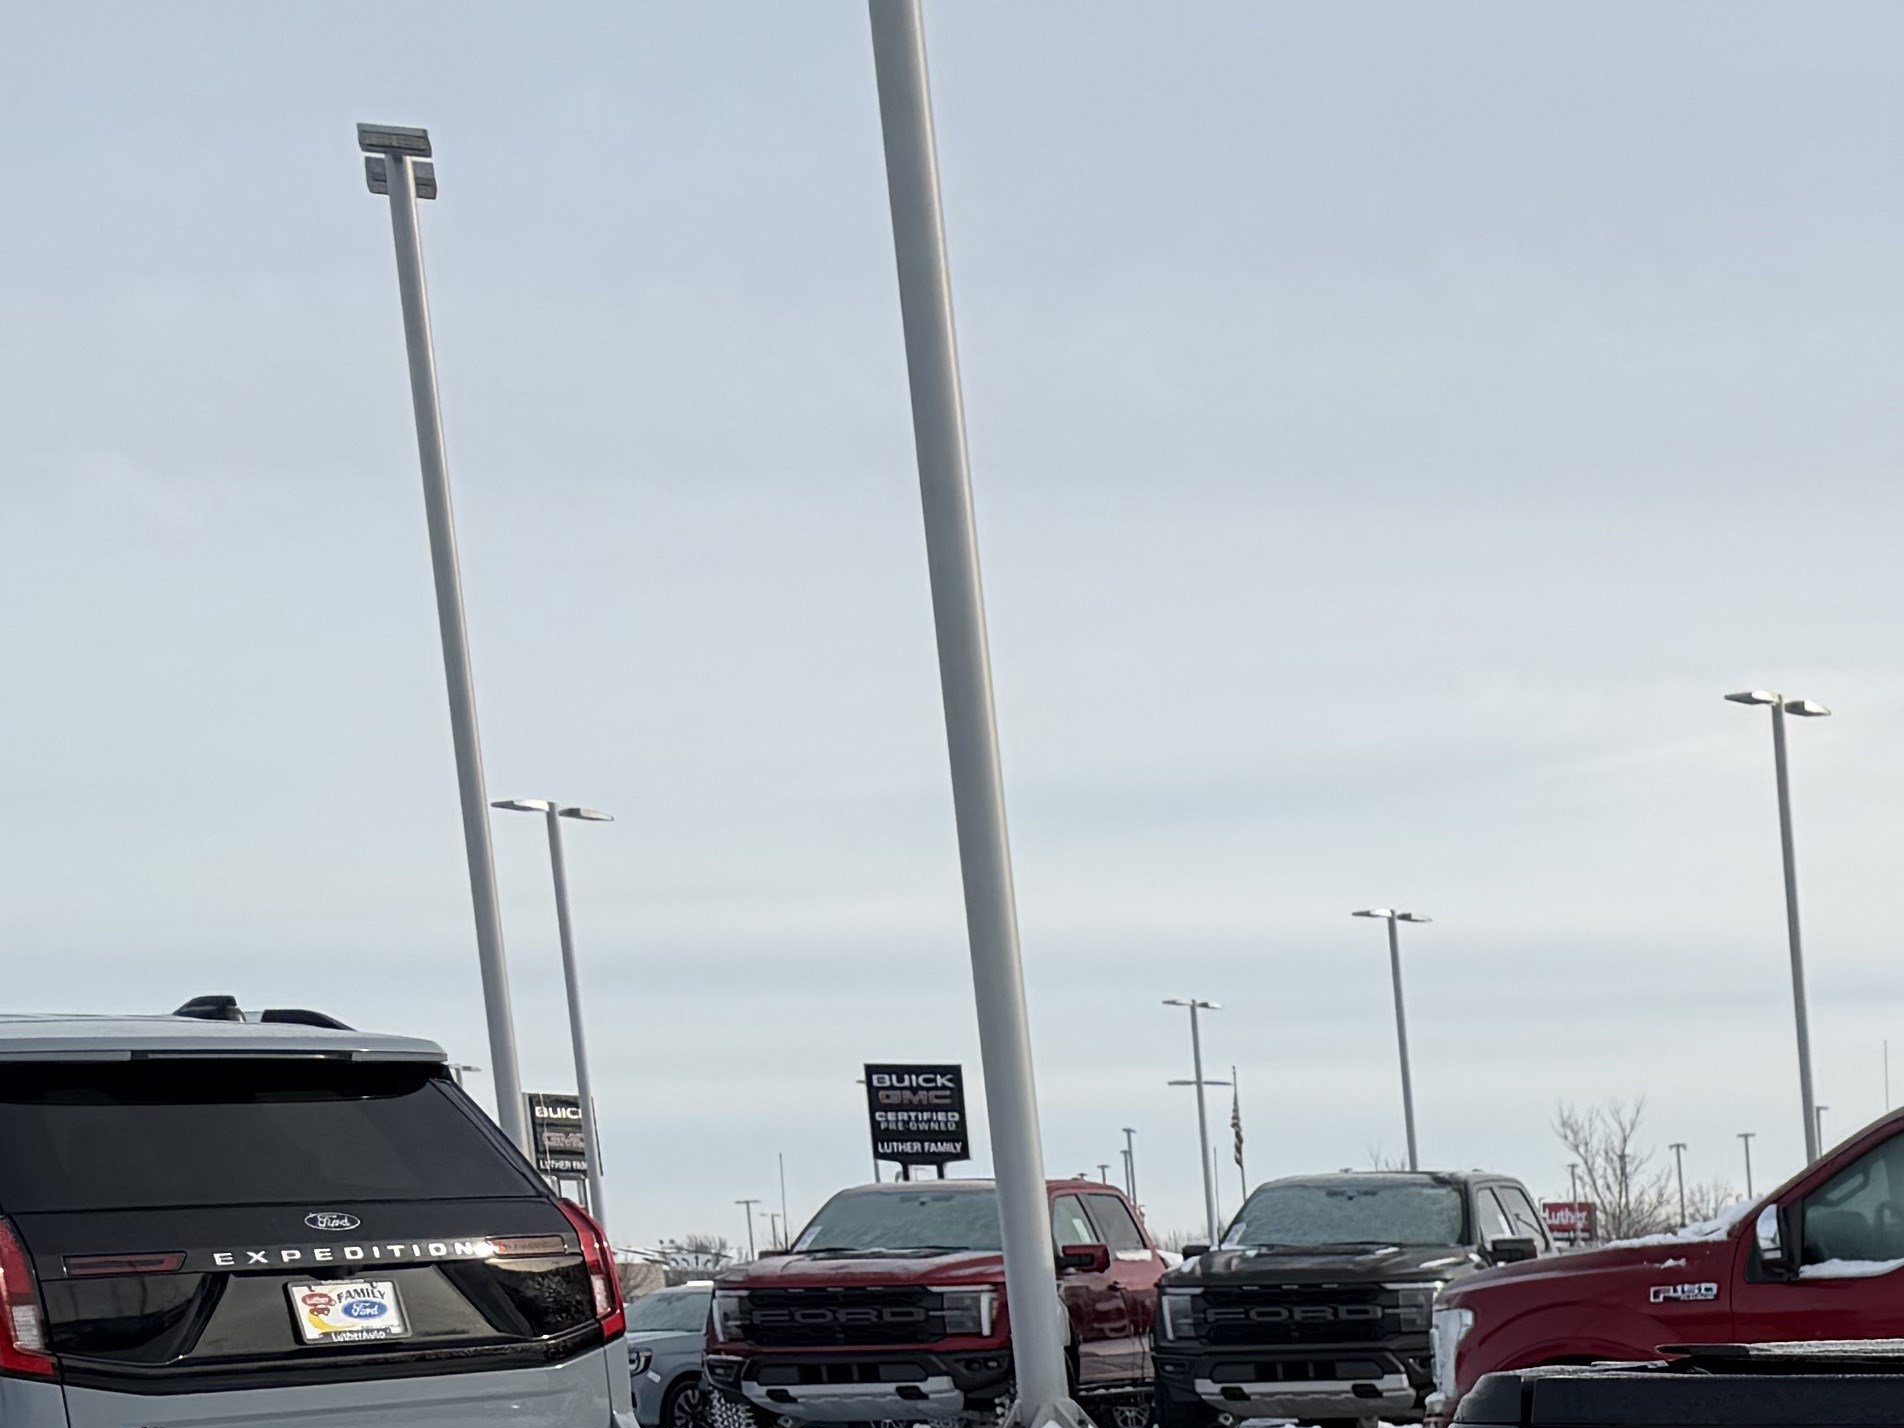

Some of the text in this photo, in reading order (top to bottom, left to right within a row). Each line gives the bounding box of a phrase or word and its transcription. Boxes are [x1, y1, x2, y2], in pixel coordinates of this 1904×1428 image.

[872, 1073, 956, 1088] BUICK
[878, 1090, 952, 1104] GMC
[875, 1111, 960, 1122] CERTIFIED
[878, 1141, 962, 1153] LUTHER FAMILY
[213, 1240, 474, 1266] EXPEDITION
[336, 1287, 386, 1304] FAMILY
[351, 1302, 379, 1316] Ford
[752, 1307, 928, 1324] FORD
[1206, 1305, 1383, 1323] FORD
